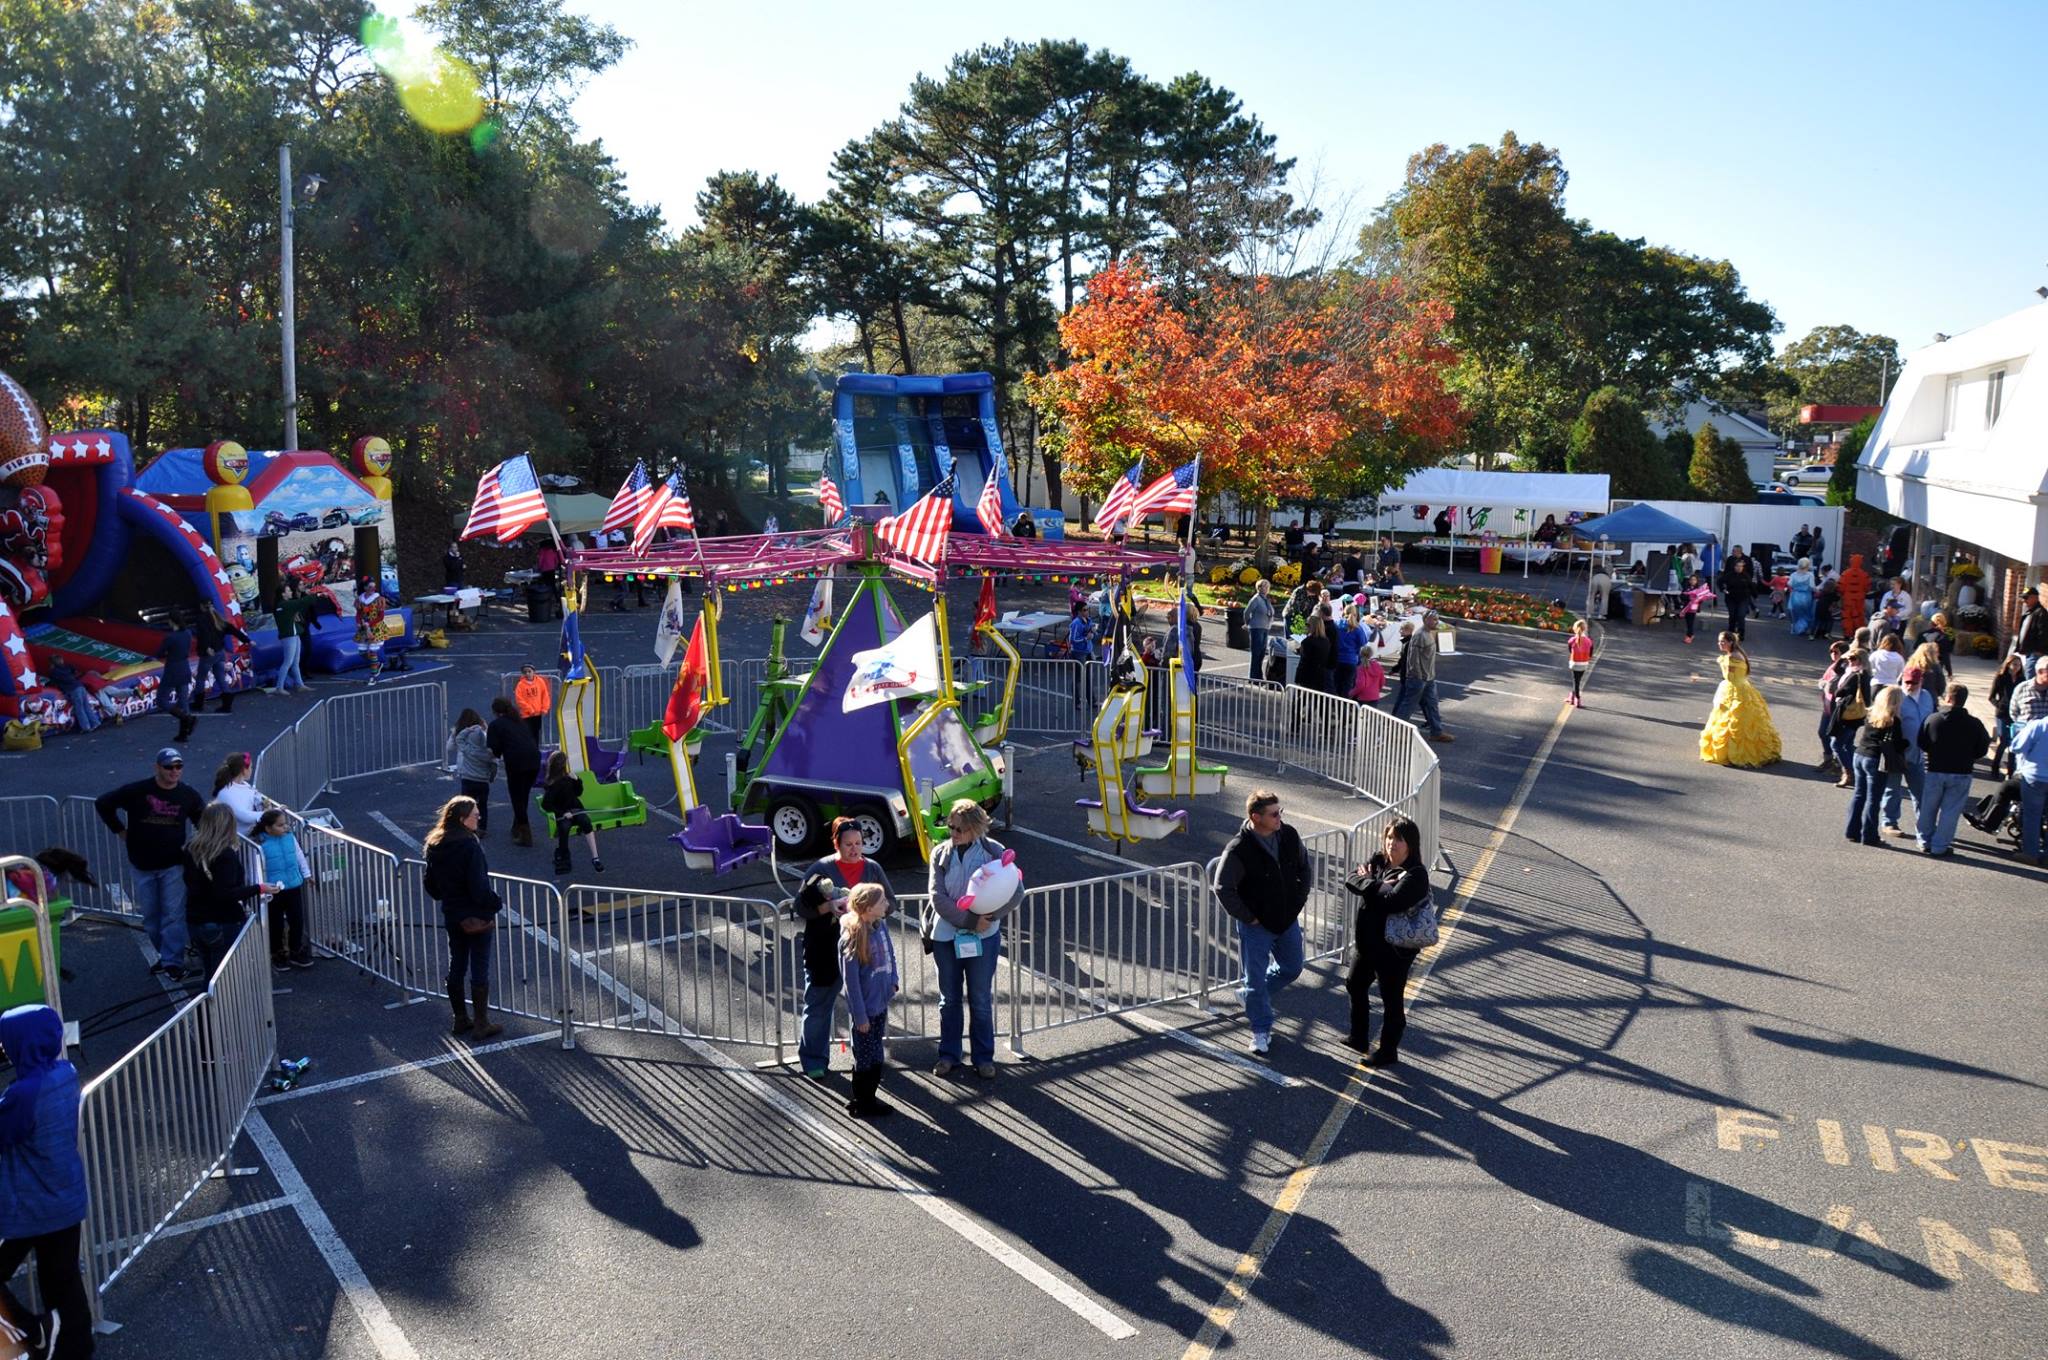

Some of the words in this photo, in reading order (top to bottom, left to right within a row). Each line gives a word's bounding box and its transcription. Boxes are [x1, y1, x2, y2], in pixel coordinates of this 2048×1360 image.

[5, 455, 37, 472] FIRST
[1715, 1106, 2048, 1195] FIRE
[1685, 1180, 2048, 1293] LAN
